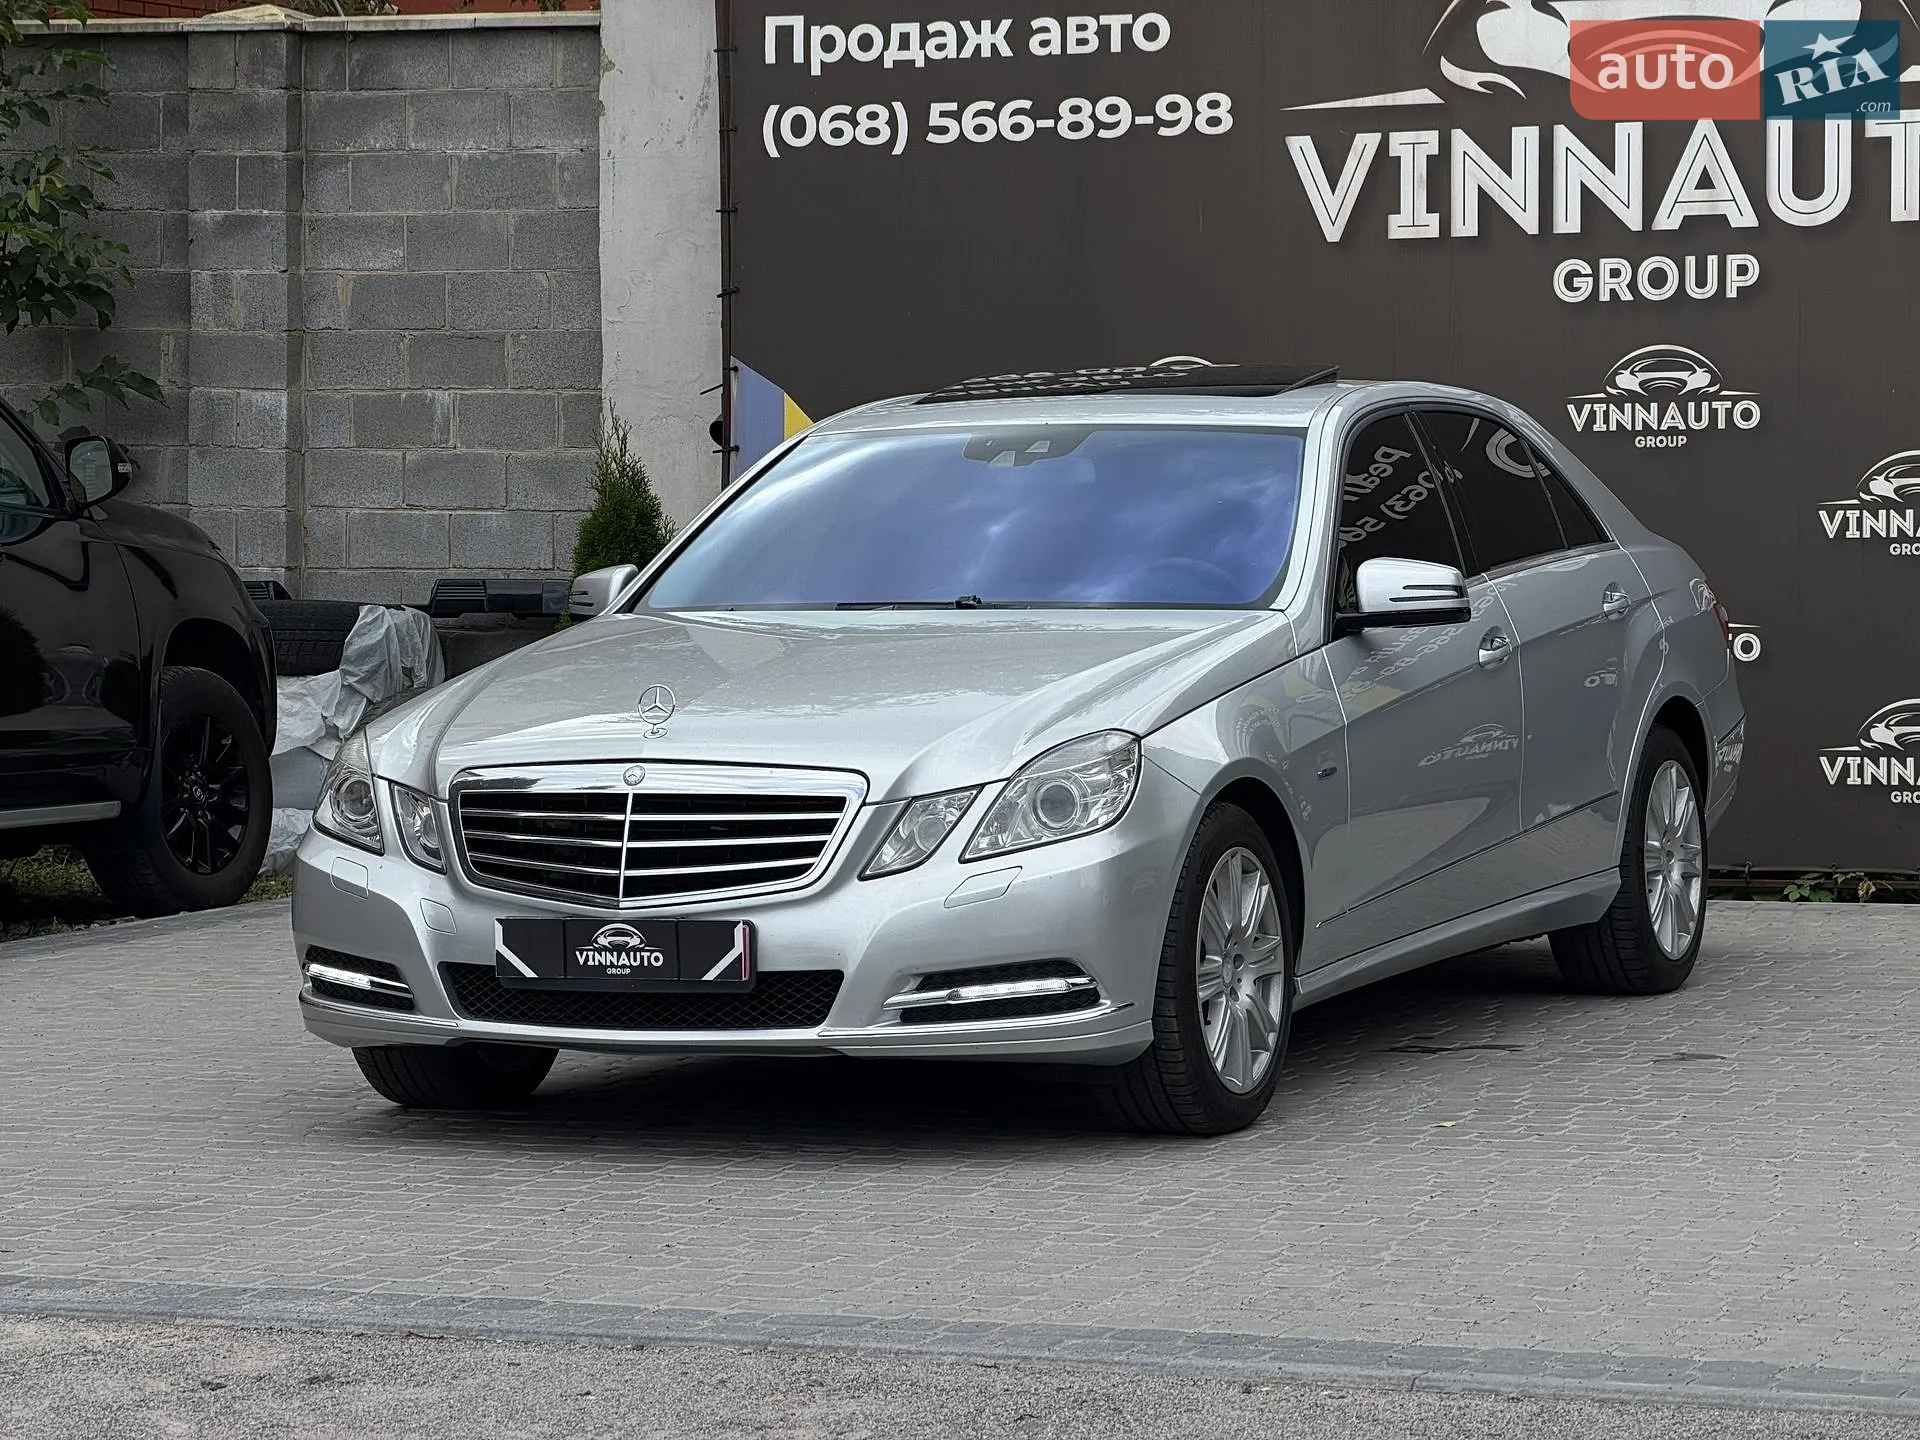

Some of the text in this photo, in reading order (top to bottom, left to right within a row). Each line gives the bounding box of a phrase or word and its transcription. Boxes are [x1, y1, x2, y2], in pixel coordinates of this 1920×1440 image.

[765, 13, 1170, 75] Продаж авто
[763, 93, 1233, 157] (068) 566-89-98
[1553, 254, 1759, 303] GROUP
[1567, 400, 1760, 432] VINNAUTO
[1634, 435, 1687, 448] GROUP
[1818, 509, 1920, 539] VINN
[1819, 756, 1920, 786] VINN
[576, 951, 663, 967] VINNAUTO
